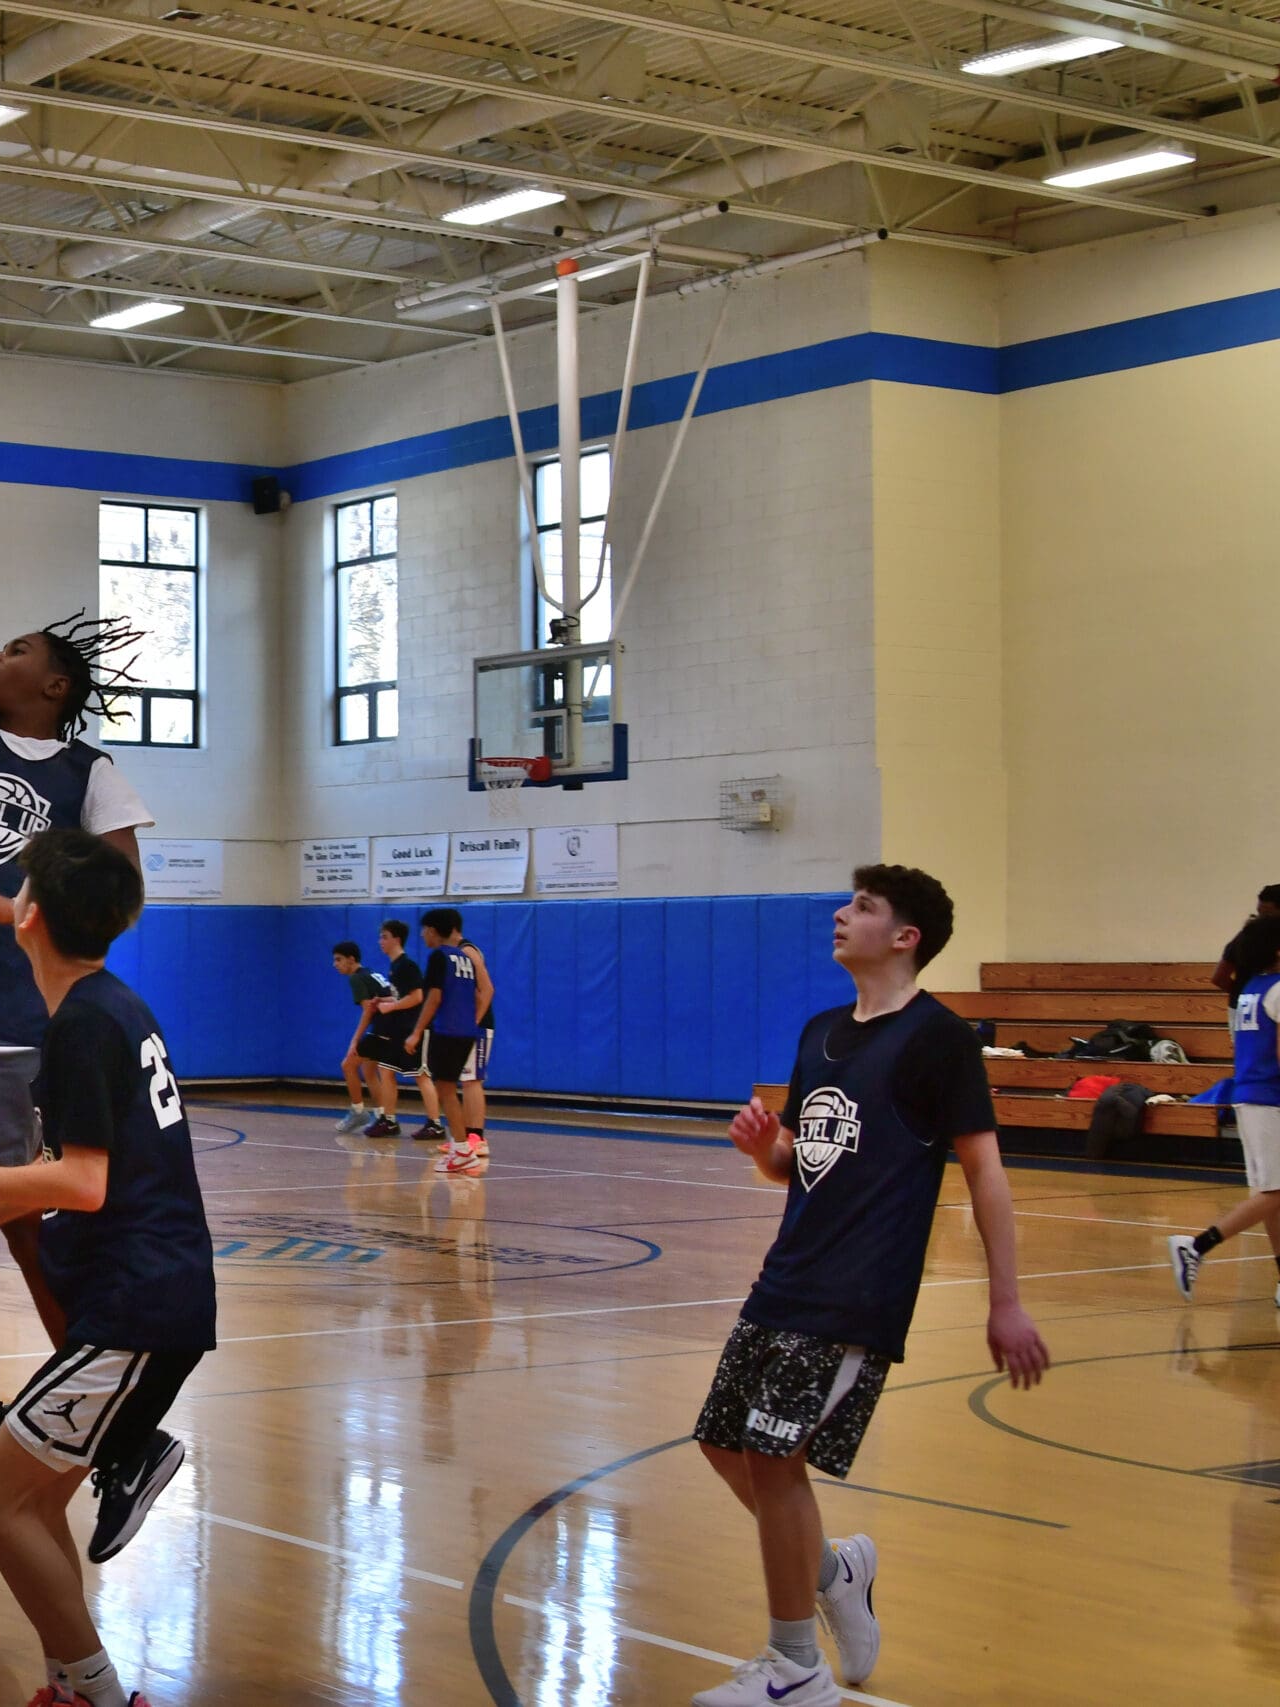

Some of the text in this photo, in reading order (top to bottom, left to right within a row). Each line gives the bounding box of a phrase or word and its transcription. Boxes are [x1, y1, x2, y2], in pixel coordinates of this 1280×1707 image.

[18, 810, 47, 836] UP
[460, 838, 520, 852] Driscoll Family
[392, 846, 432, 859] Good Luck
[381, 869, 392, 878] The
[833, 1120, 857, 1146] UP
